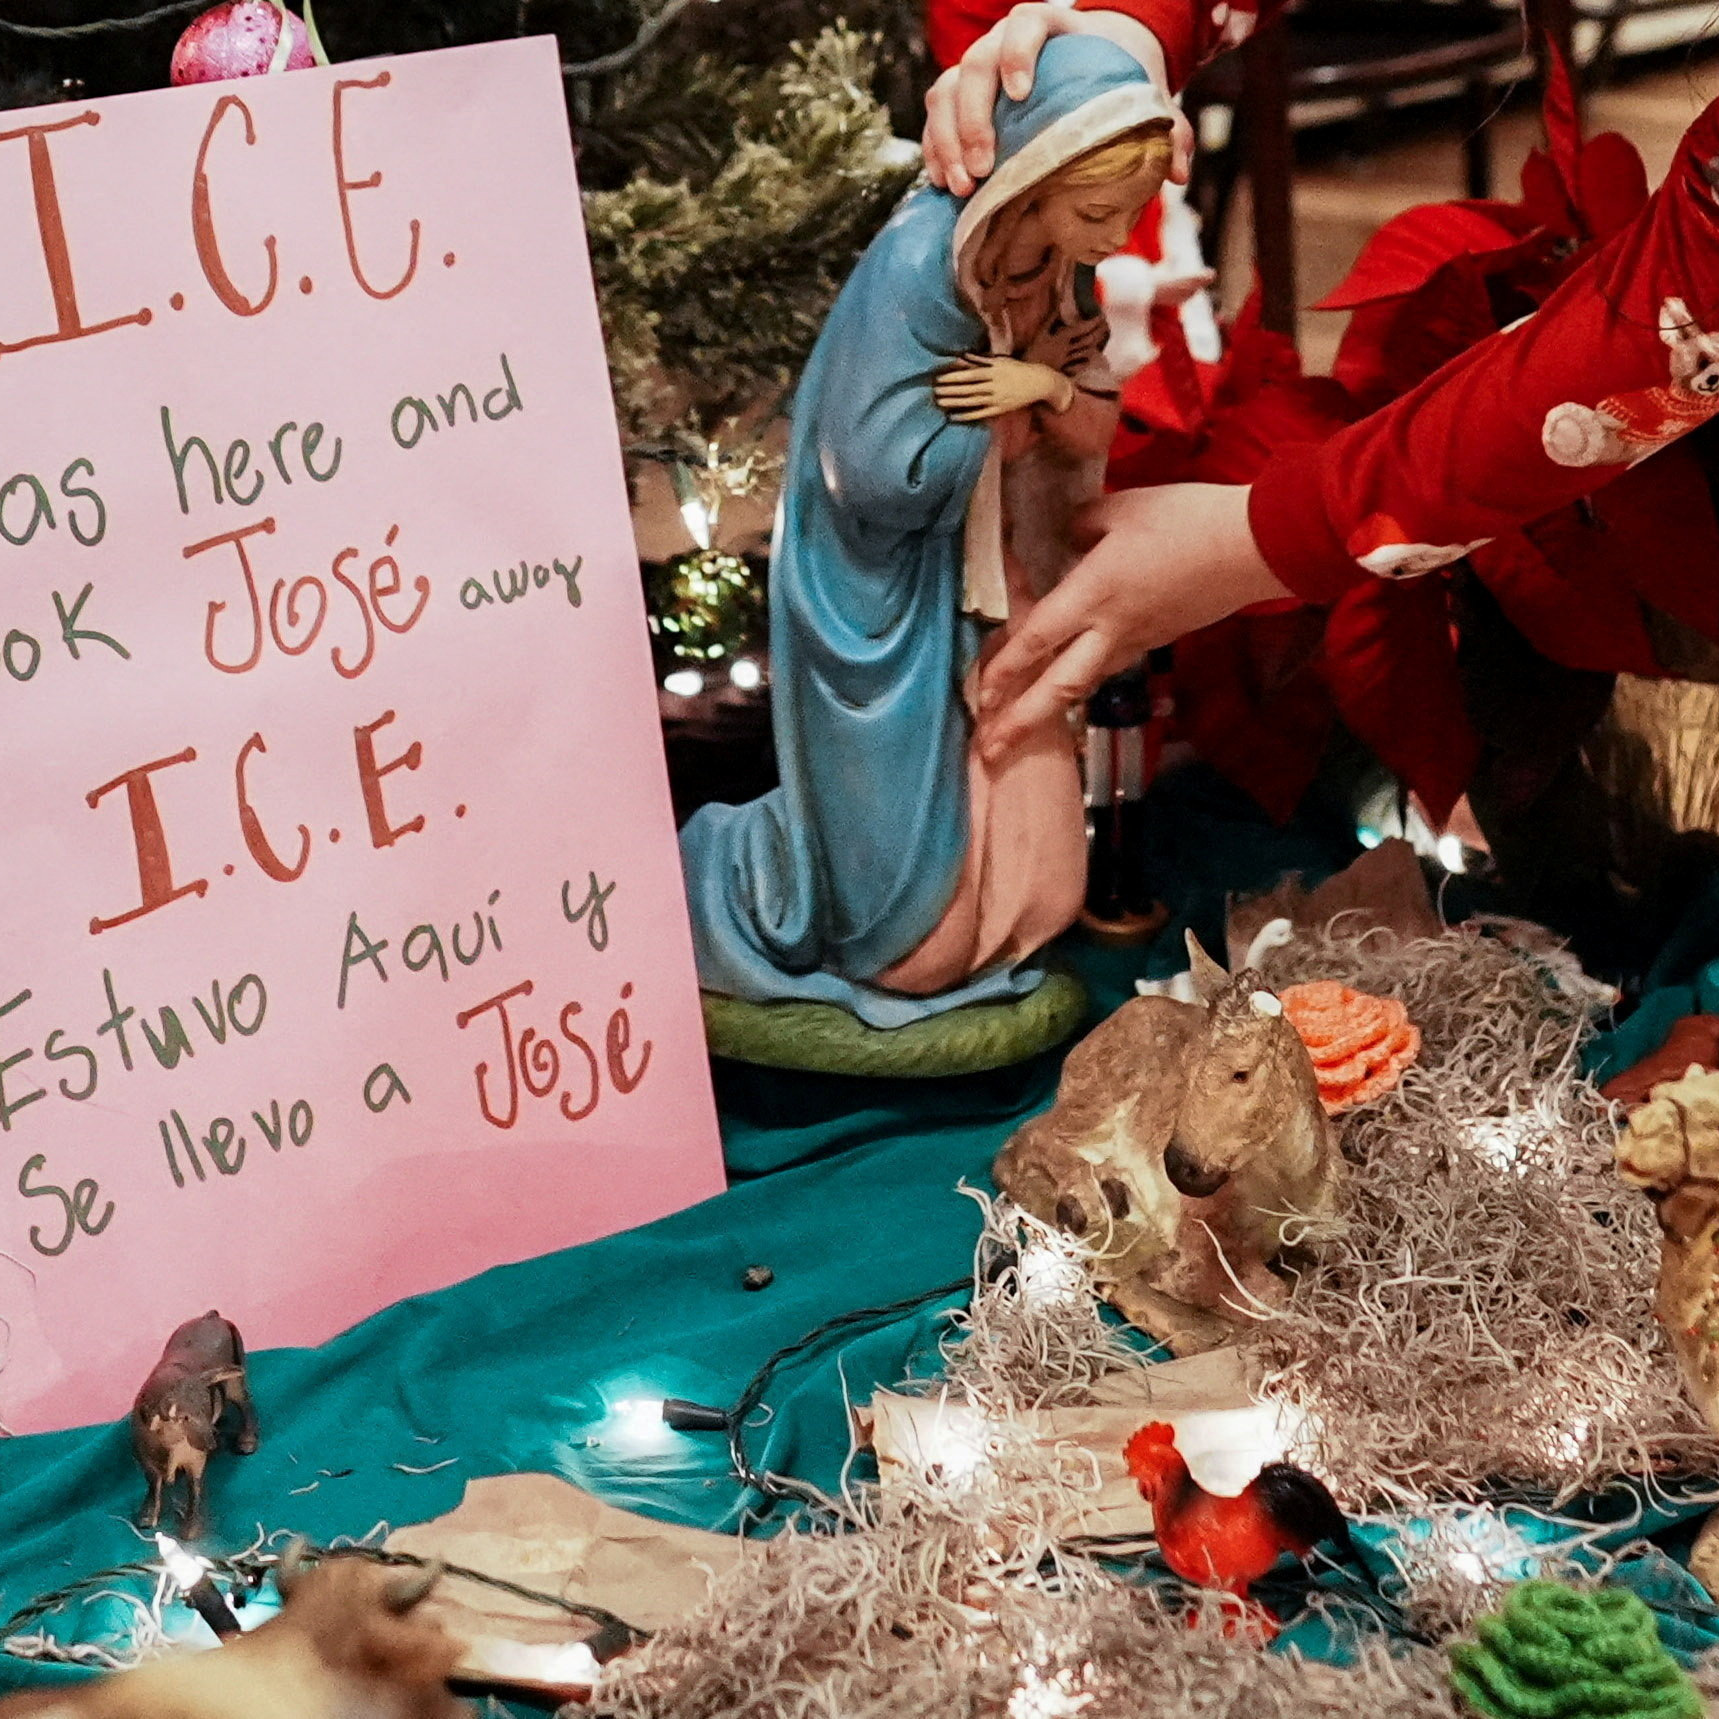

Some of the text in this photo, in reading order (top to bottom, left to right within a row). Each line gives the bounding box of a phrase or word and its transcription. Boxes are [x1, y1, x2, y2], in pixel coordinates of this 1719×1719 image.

[160, 405, 344, 516] here
[390, 352, 525, 451] and
[180, 515, 432, 680] José
[83, 708, 468, 937] I.C.E.
[336, 887, 504, 1011] Aquí
[560, 869, 618, 954] y
[17, 978, 653, 1258] Se llevo a José
